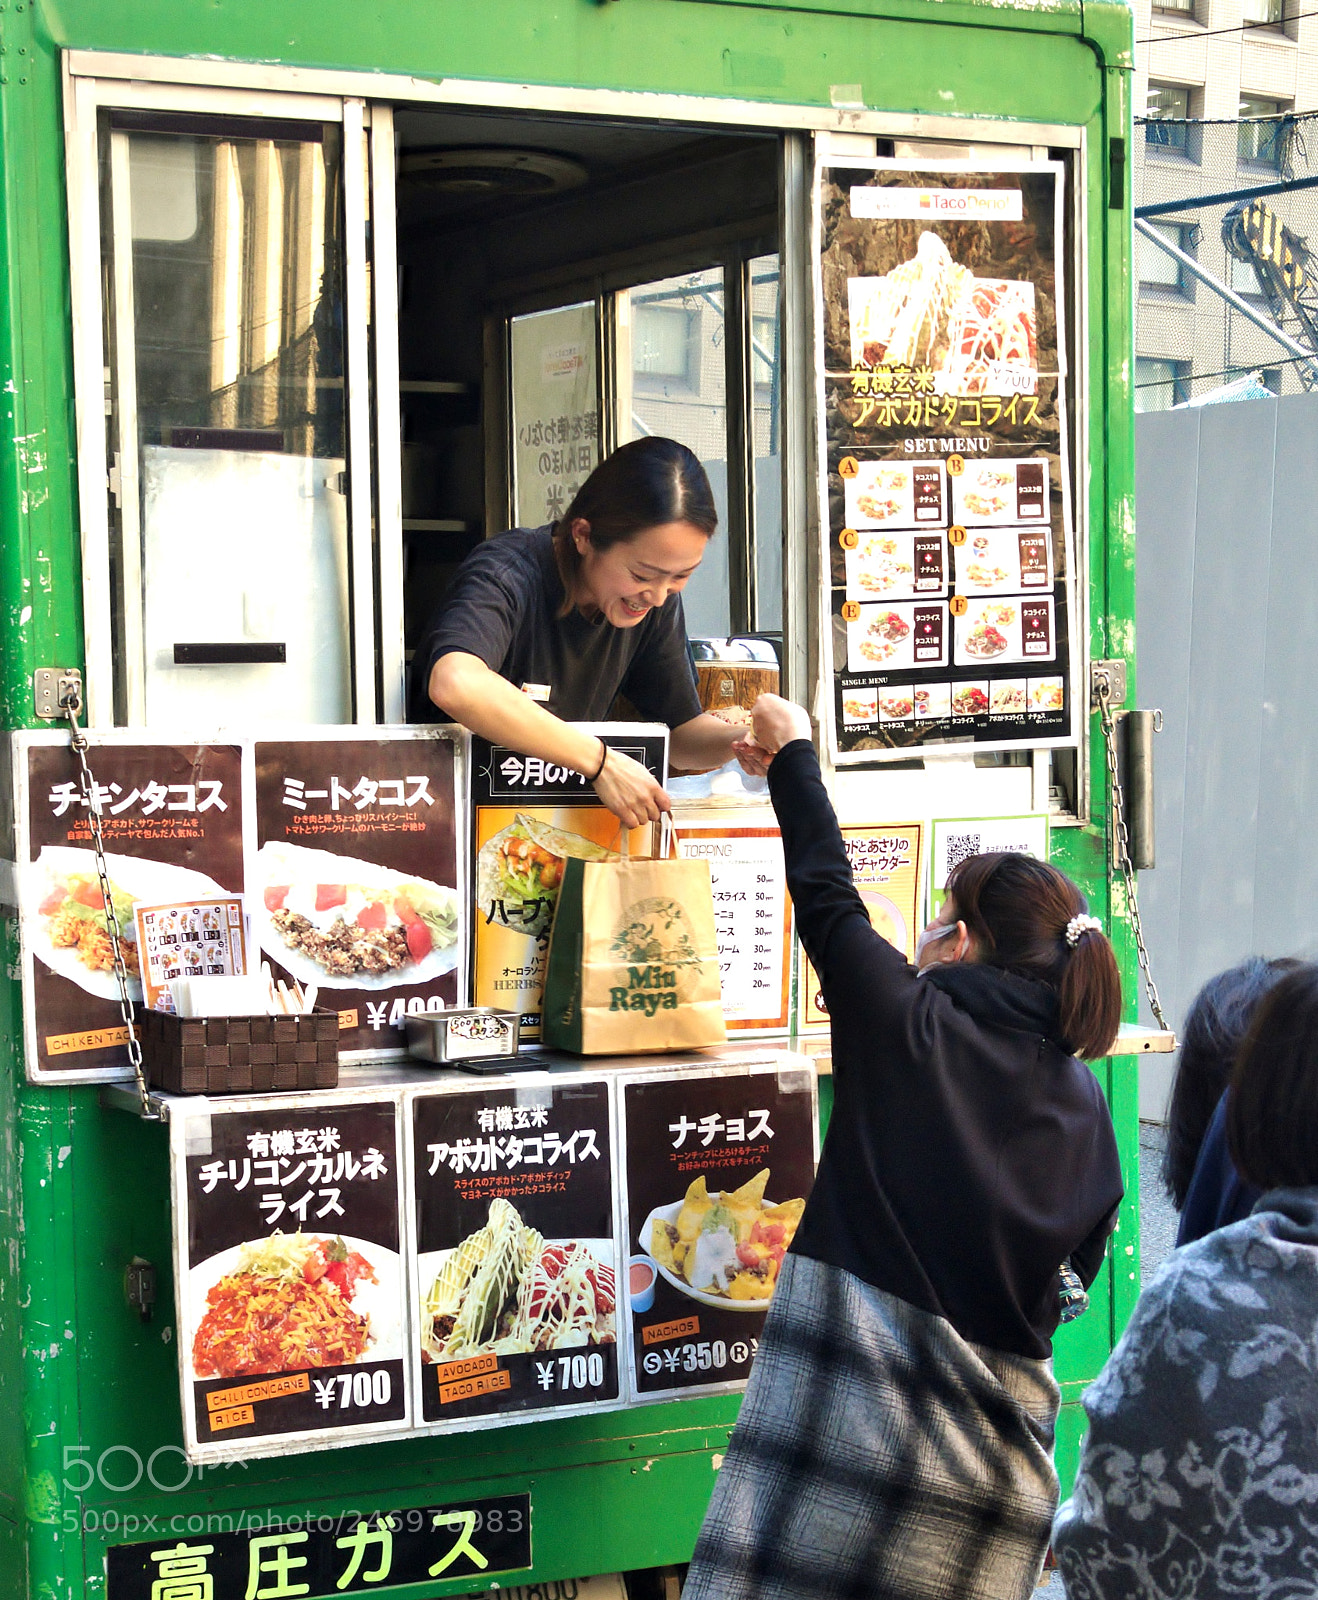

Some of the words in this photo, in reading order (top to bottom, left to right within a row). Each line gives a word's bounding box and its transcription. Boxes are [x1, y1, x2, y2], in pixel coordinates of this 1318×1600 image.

[851, 391, 1043, 428] アボカドタコライス
[904, 438, 939, 453] SET
[940, 437, 990, 452] MENU
[841, 678, 866, 687] SINGLE
[868, 676, 888, 685] MENU
[49, 780, 228, 817] チキンタコス
[282, 775, 436, 811] ミートタコス
[73, 817, 199, 830] とり肉アボカド、サワークリームを
[684, 844, 732, 857] TOPPING
[609, 986, 678, 1018] Raya
[53, 1036, 102, 1050] CHIKEN
[477, 1103, 549, 1132] 有機玄米
[668, 1109, 775, 1149] ナチョス
[247, 1126, 341, 1158] 有機玄米
[427, 1128, 601, 1176] アボカドタコライス
[199, 1148, 388, 1194] チリコンカルネ
[259, 1188, 345, 1225] ライス
[647, 1321, 694, 1340] NACHOS
[443, 1357, 493, 1378] AVOCADO
[536, 1353, 604, 1391] ¥700
[213, 1390, 245, 1406] CHILI
[247, 1387, 268, 1399] CON
[271, 1378, 304, 1394] CARNE
[312, 1369, 392, 1410] ¥700
[445, 1383, 472, 1398] TACO
[477, 1375, 506, 1391] RICE
[215, 1410, 248, 1425] RICE
[150, 1510, 489, 1600] 高圧ガス
